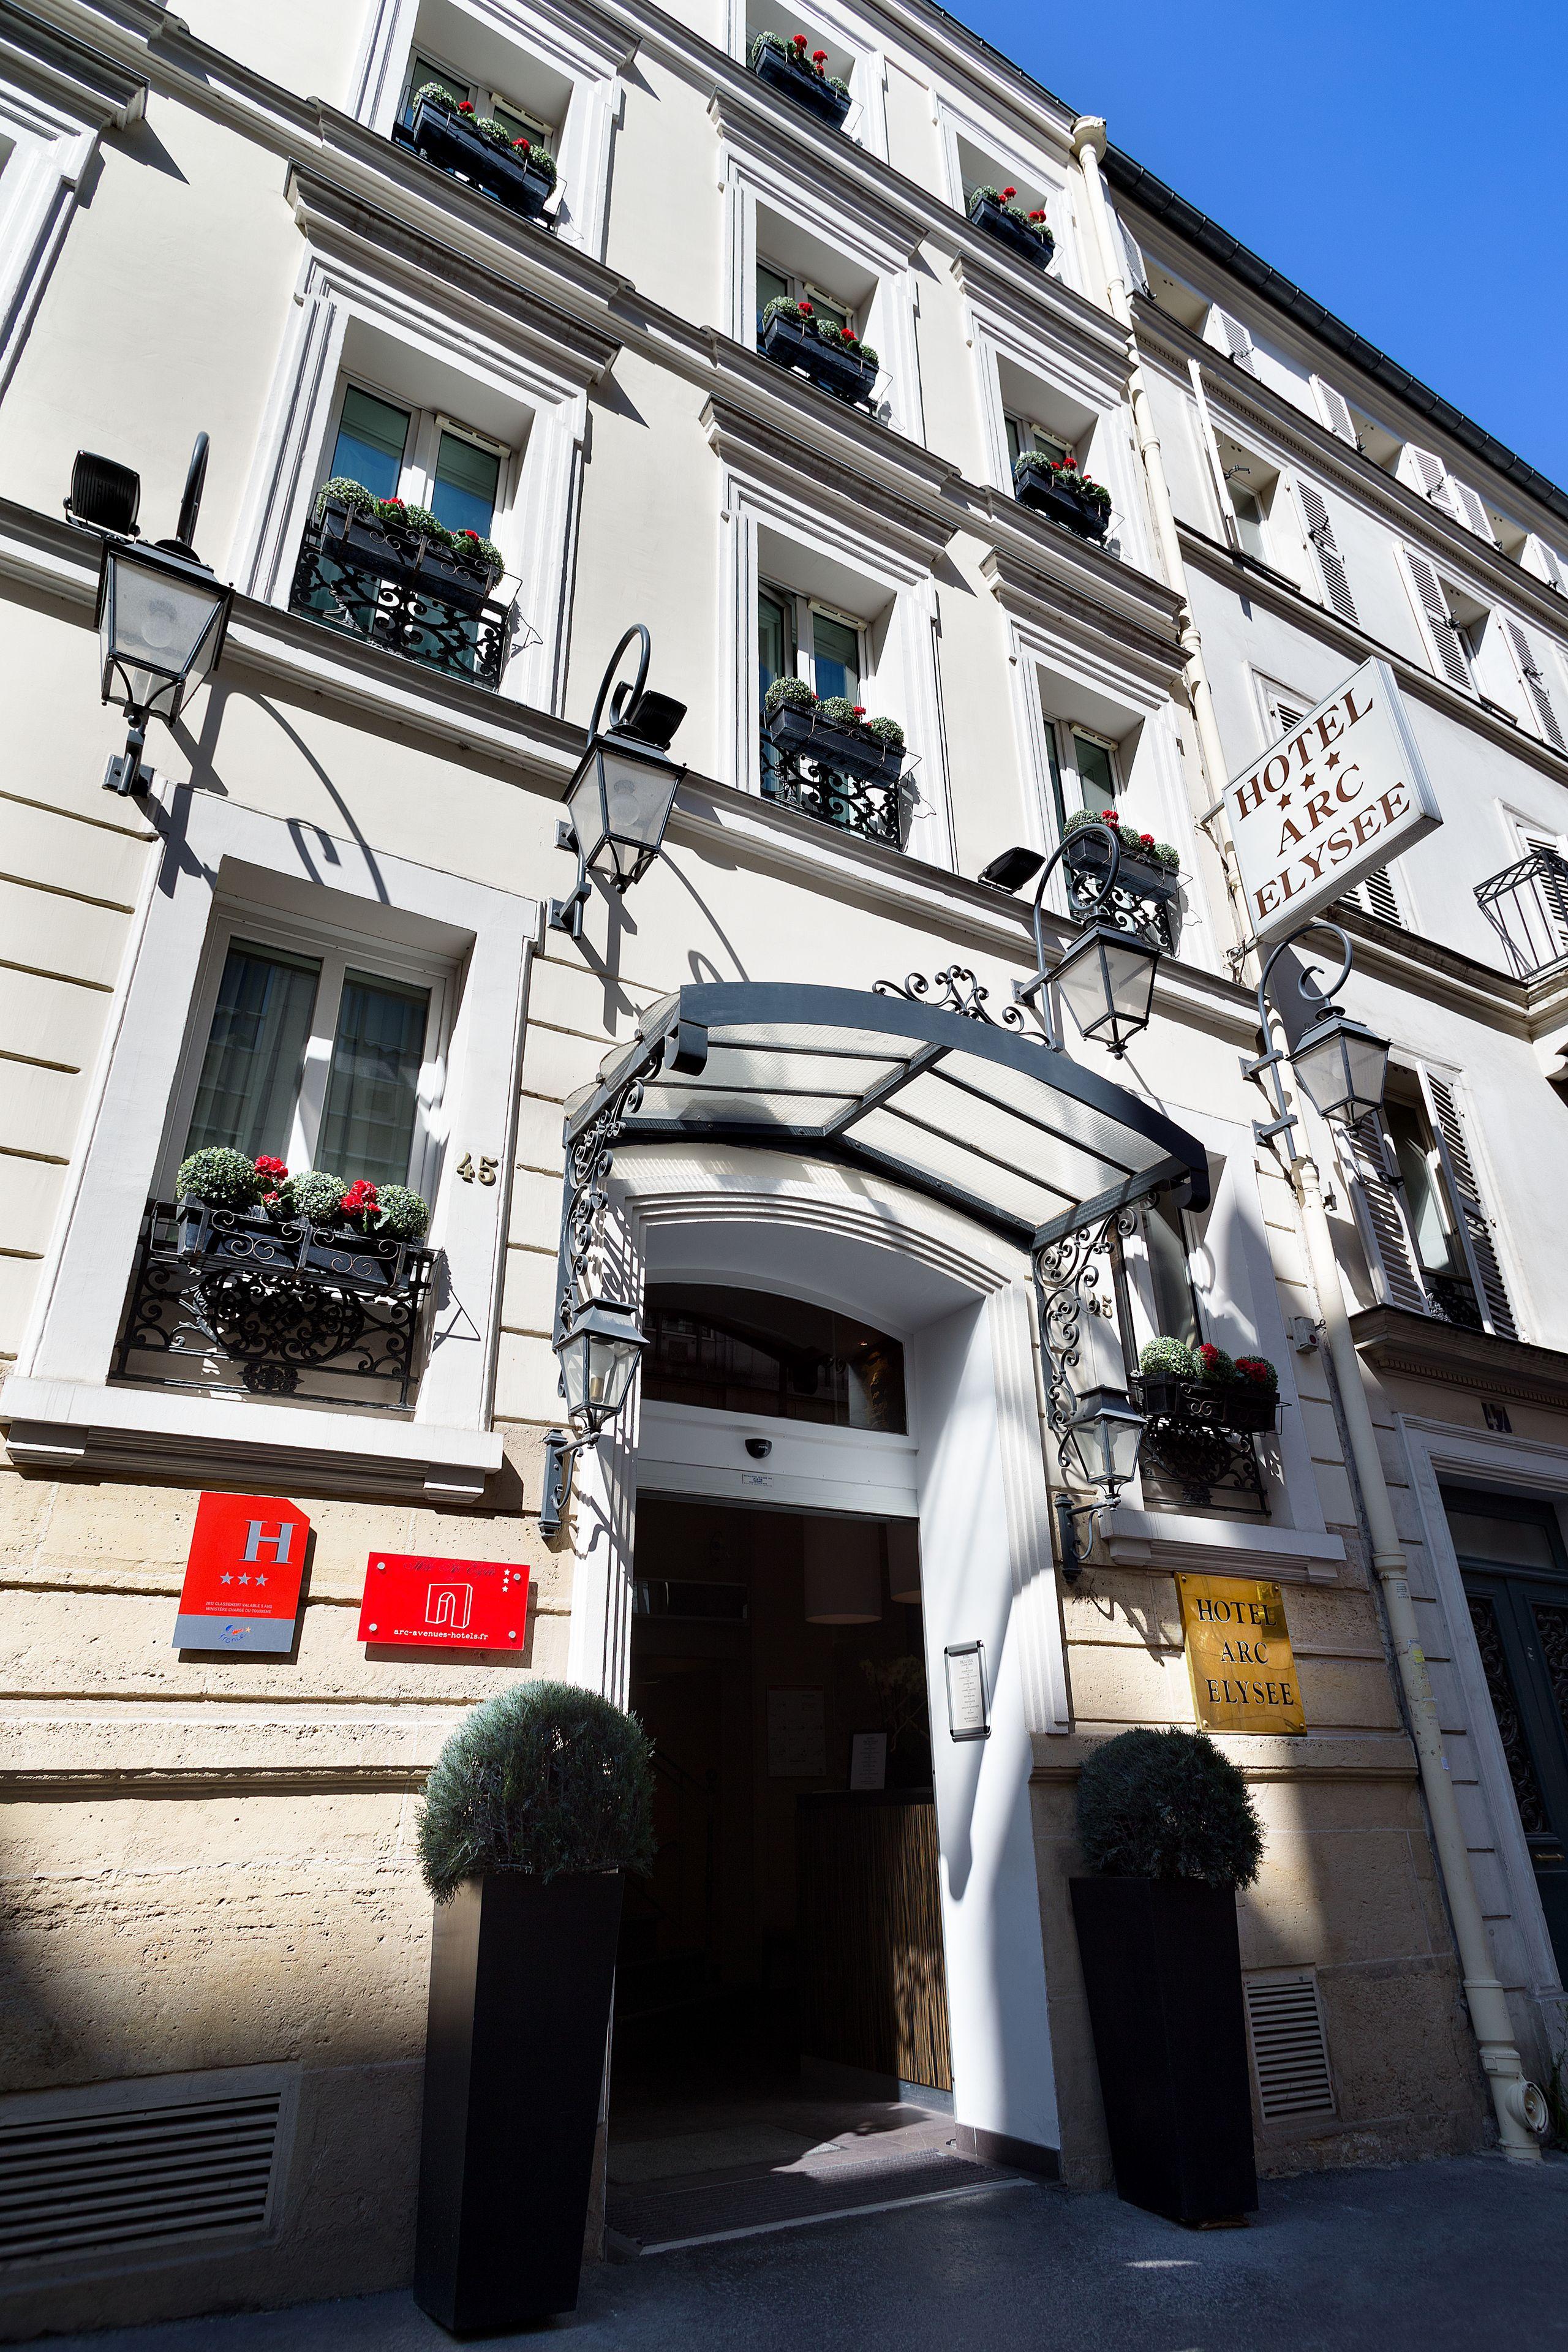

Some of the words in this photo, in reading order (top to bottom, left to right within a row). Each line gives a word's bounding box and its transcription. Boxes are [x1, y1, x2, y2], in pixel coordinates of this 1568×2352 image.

[1233, 687, 1373, 821] HOTEL
[1276, 764, 1364, 858] ARC
[1253, 782, 1410, 921] ELYSEE
[456, 1152, 499, 1186] 45
[237, 1519, 300, 1564] H
[1196, 1598, 1276, 1626] HOTEL
[393, 1628, 488, 1640] arc-avenues-hotels.fr
[1221, 1640, 1269, 1665] ARC
[1205, 1679, 1294, 1706] ELYSEE
